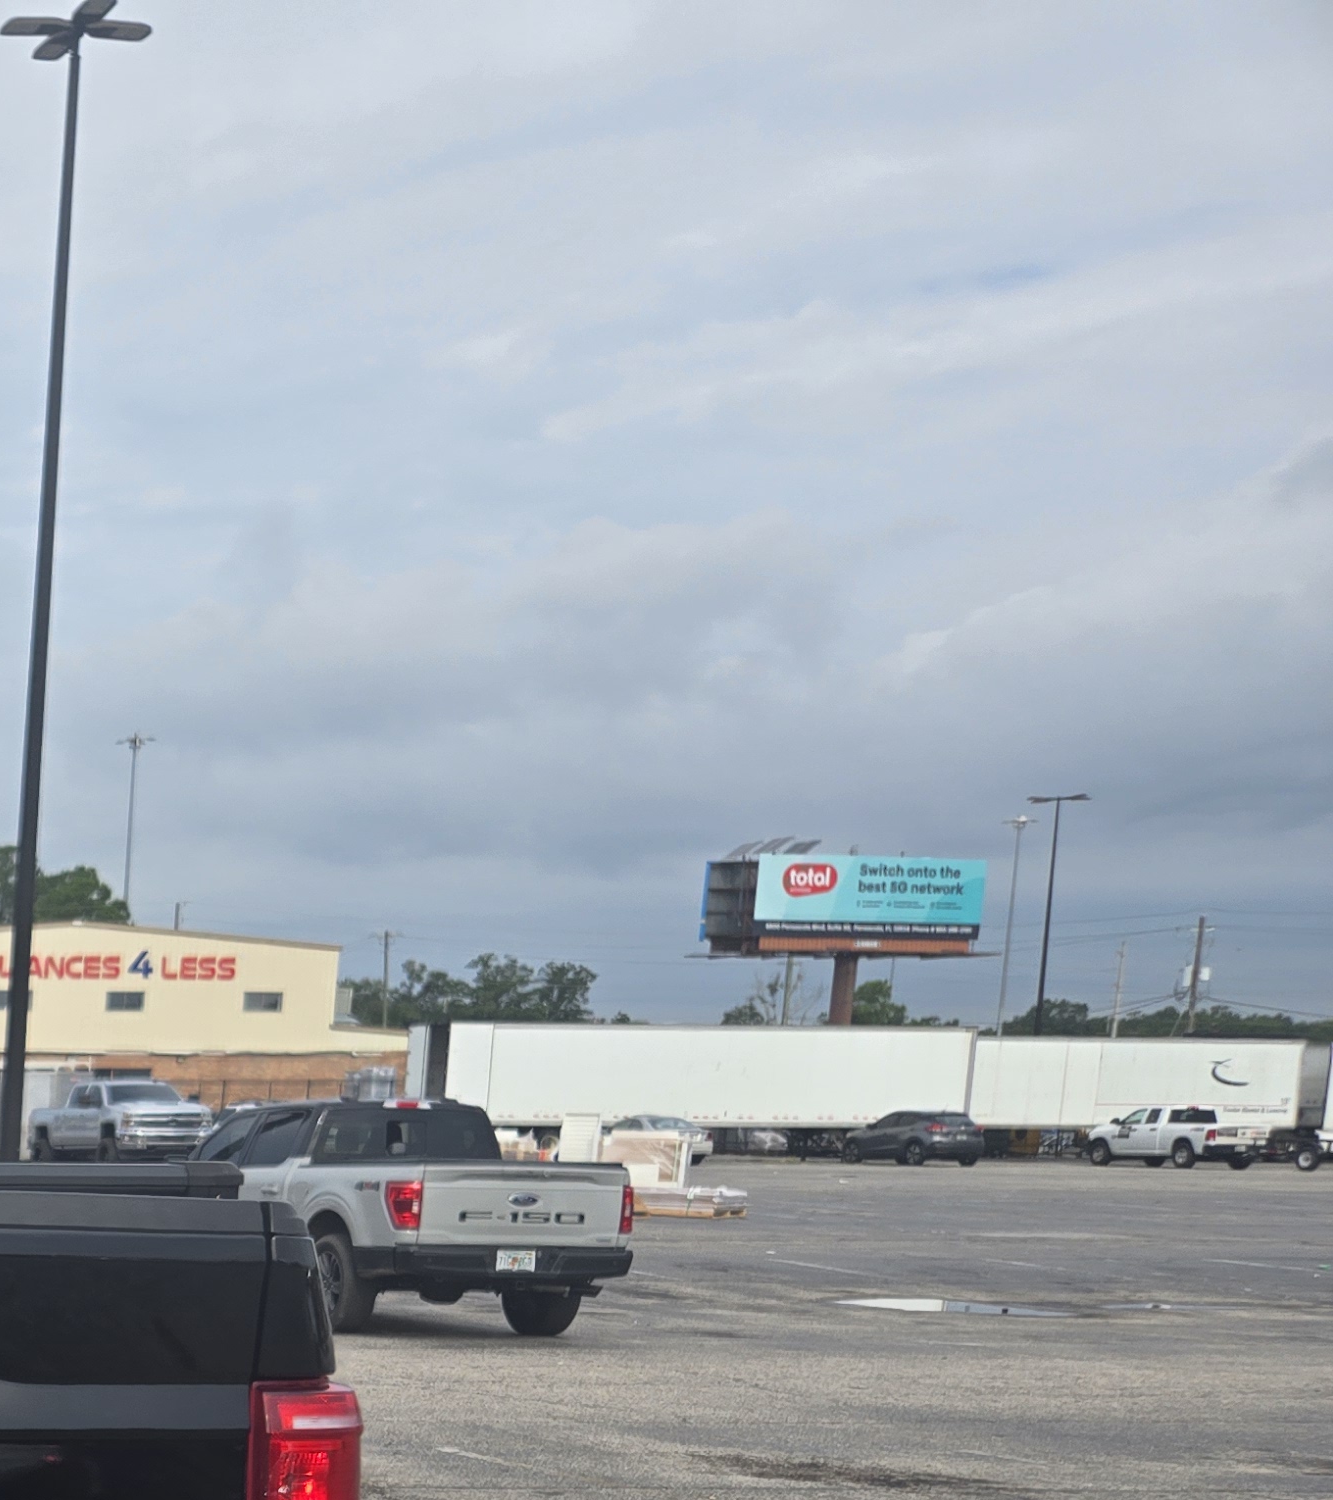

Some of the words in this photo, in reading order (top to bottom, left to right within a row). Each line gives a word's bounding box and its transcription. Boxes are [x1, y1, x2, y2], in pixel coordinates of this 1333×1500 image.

[789, 866, 831, 887] total
[859, 863, 903, 878] Switch
[907, 866, 937, 879] onto
[940, 866, 961, 880] the
[858, 880, 887, 894] best
[911, 882, 964, 896] network
[127, 950, 153, 980] 4
[161, 956, 237, 981] LESS
[458, 1210, 586, 1226] F-150
